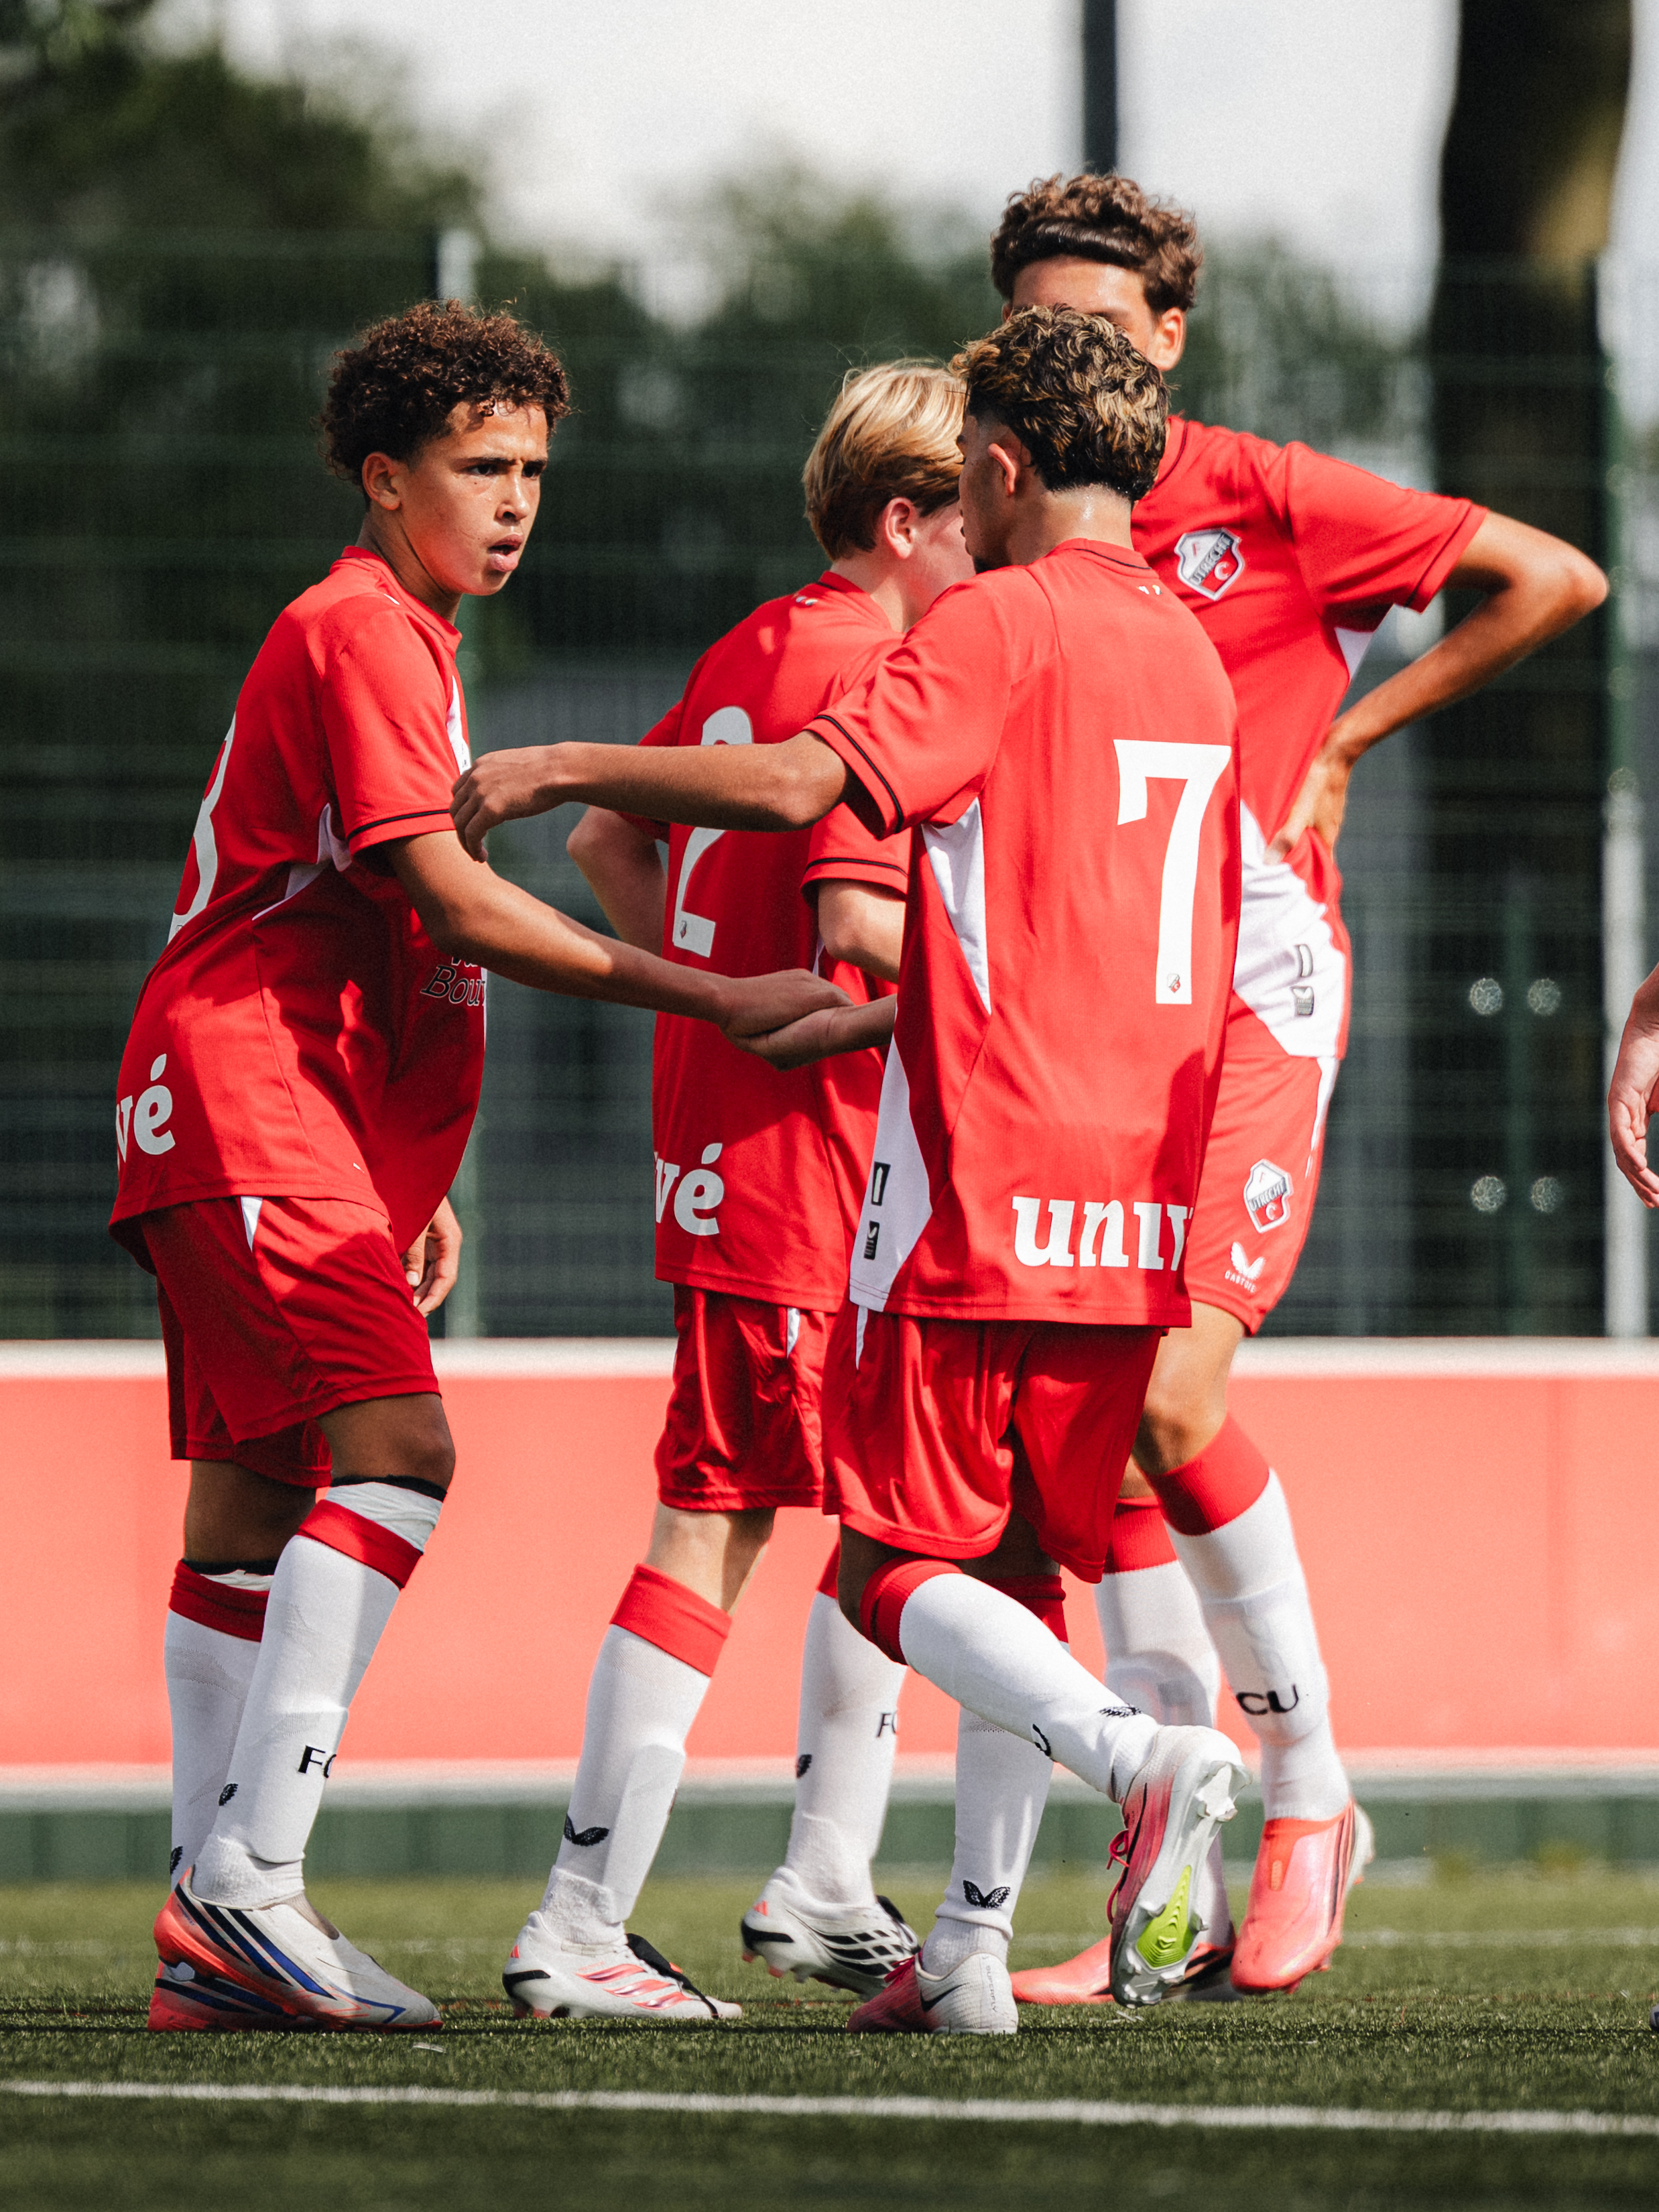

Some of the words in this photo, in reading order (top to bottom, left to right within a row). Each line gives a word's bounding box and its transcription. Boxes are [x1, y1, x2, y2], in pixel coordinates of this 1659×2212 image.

[1190, 534, 1232, 586] UTRECHT
[1215, 562, 1230, 580] C
[1113, 739, 1232, 1004] 7
[420, 964, 486, 1006] Bou
[1249, 1179, 1286, 1212] UTRECHT
[1266, 1203, 1276, 1220] C
[1236, 1684, 1299, 1715] CU
